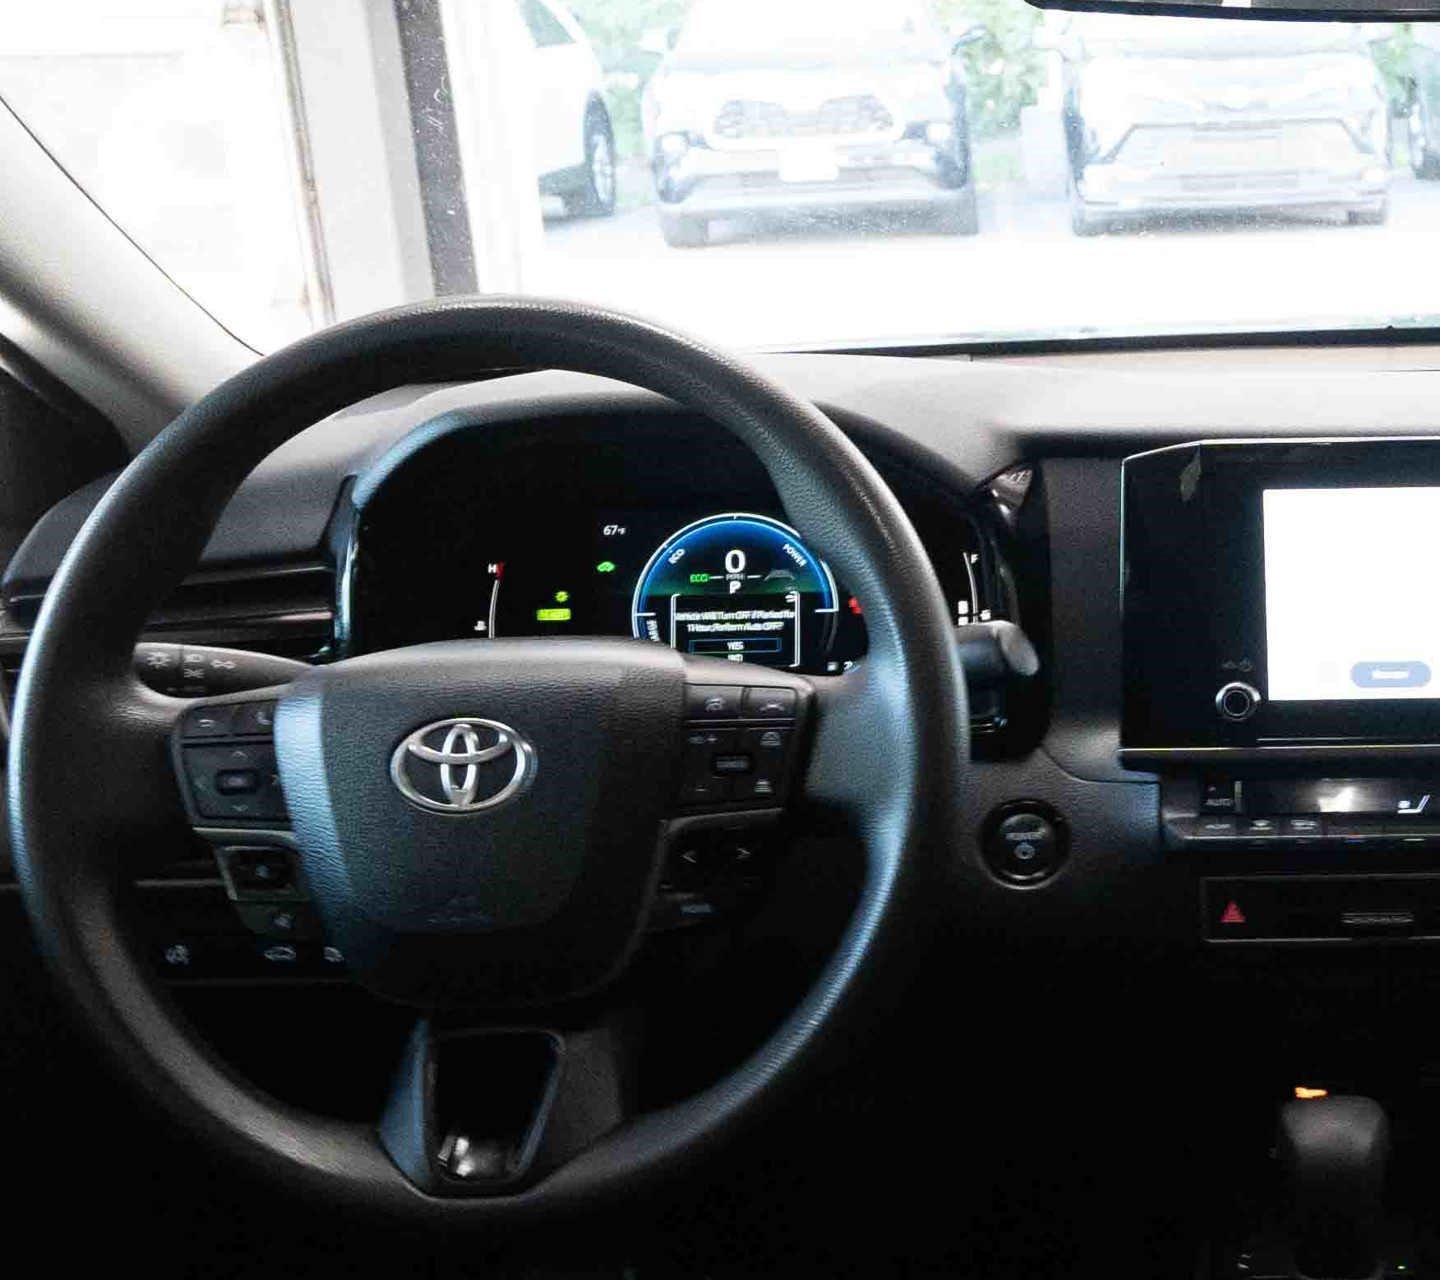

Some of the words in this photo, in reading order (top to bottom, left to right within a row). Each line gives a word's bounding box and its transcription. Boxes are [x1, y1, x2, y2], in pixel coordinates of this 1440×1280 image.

[667, 548, 686, 565] ECO
[724, 549, 746, 574] 0
[782, 543, 808, 567] POWER
[488, 563, 497, 574] H
[729, 581, 742, 595] P
[727, 641, 745, 651] YES
